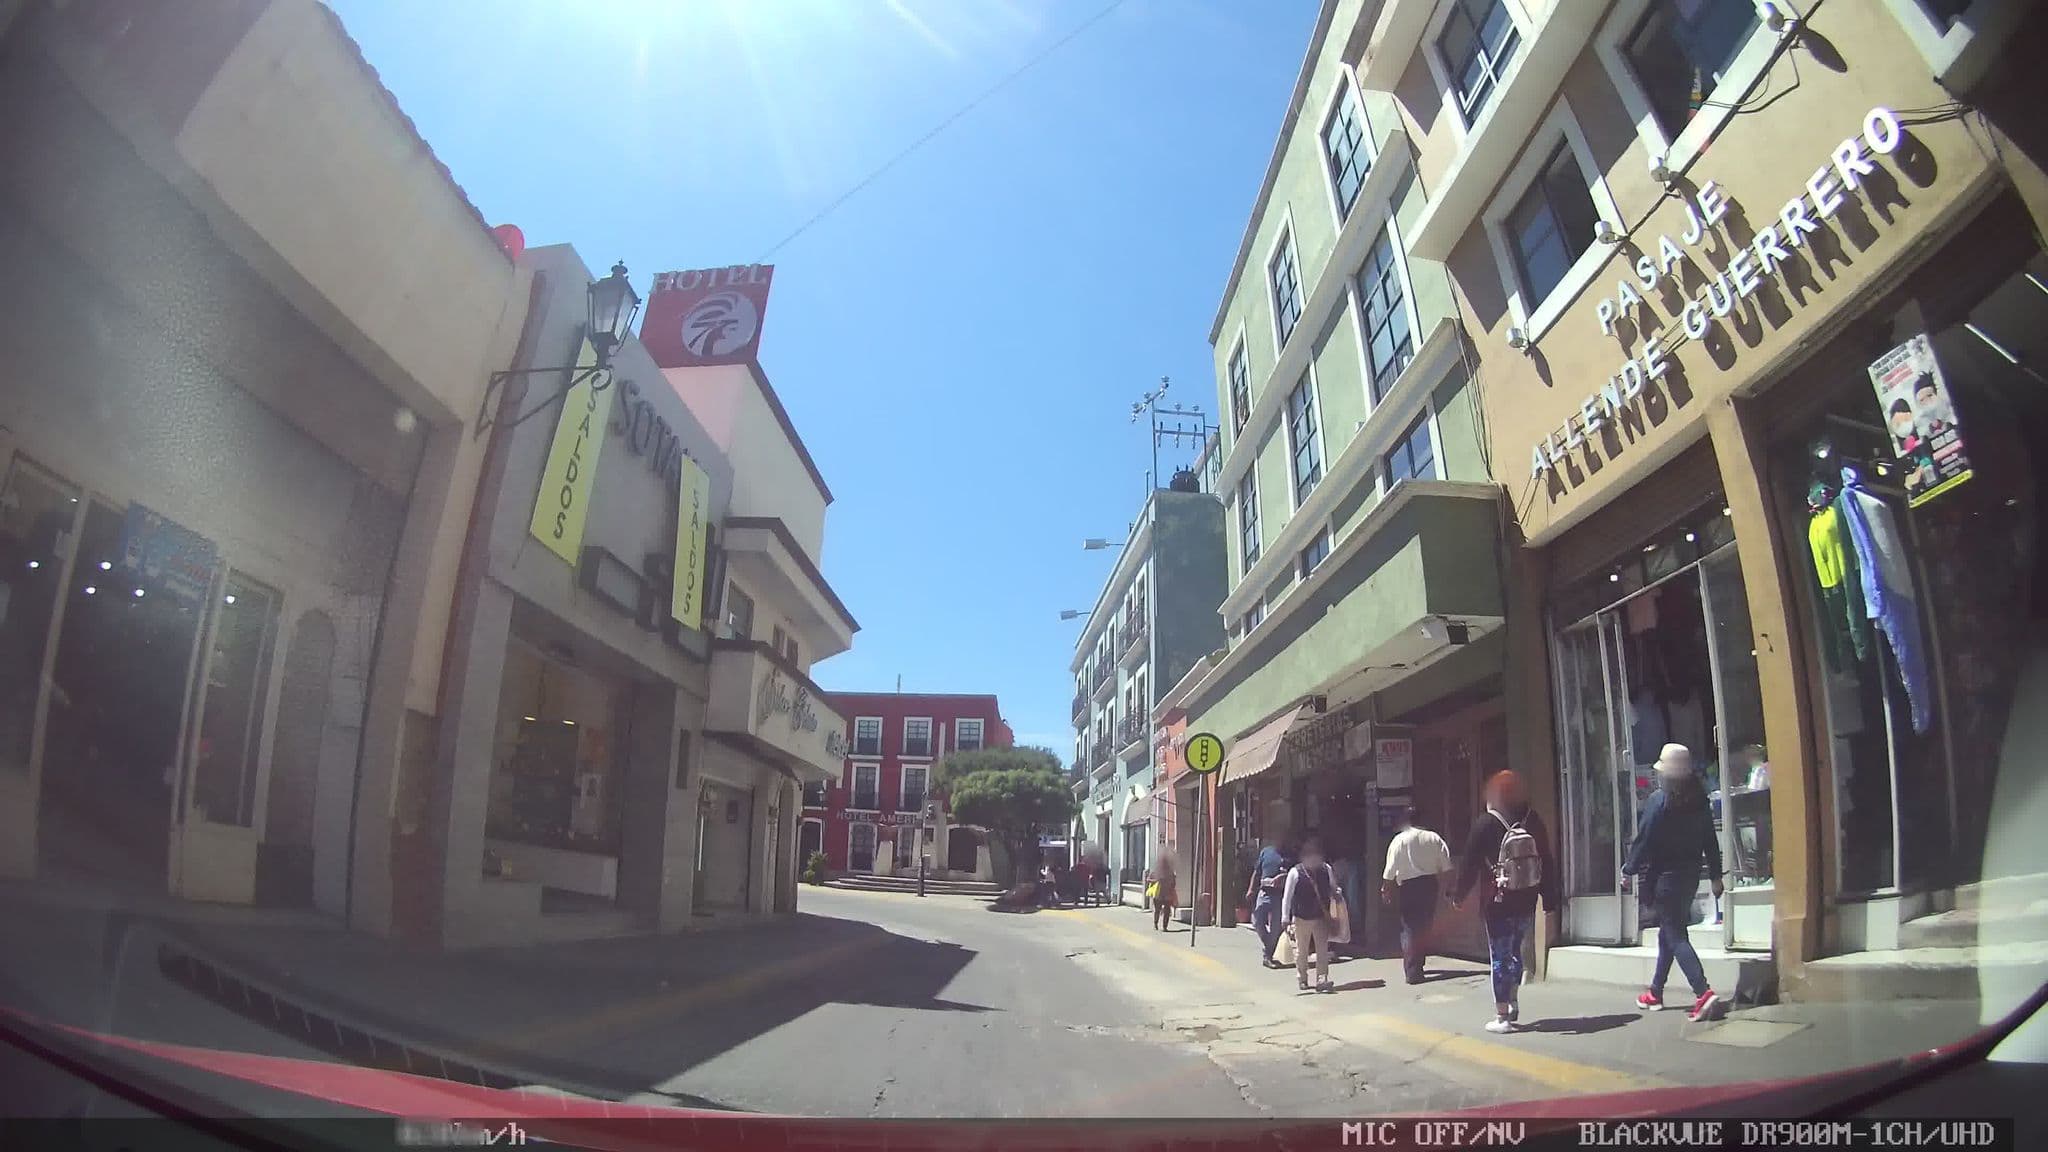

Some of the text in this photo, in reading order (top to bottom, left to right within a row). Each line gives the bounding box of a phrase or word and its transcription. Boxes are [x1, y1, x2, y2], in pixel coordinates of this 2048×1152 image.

[648, 263, 768, 294] HOTEL
[1531, 106, 1902, 479] ALLENDE GUERRERO
[1596, 179, 1728, 336] PASAJE
[552, 385, 597, 540] SALDOS
[683, 489, 702, 615] SALDOS
[836, 809, 872, 822] HOTEL
